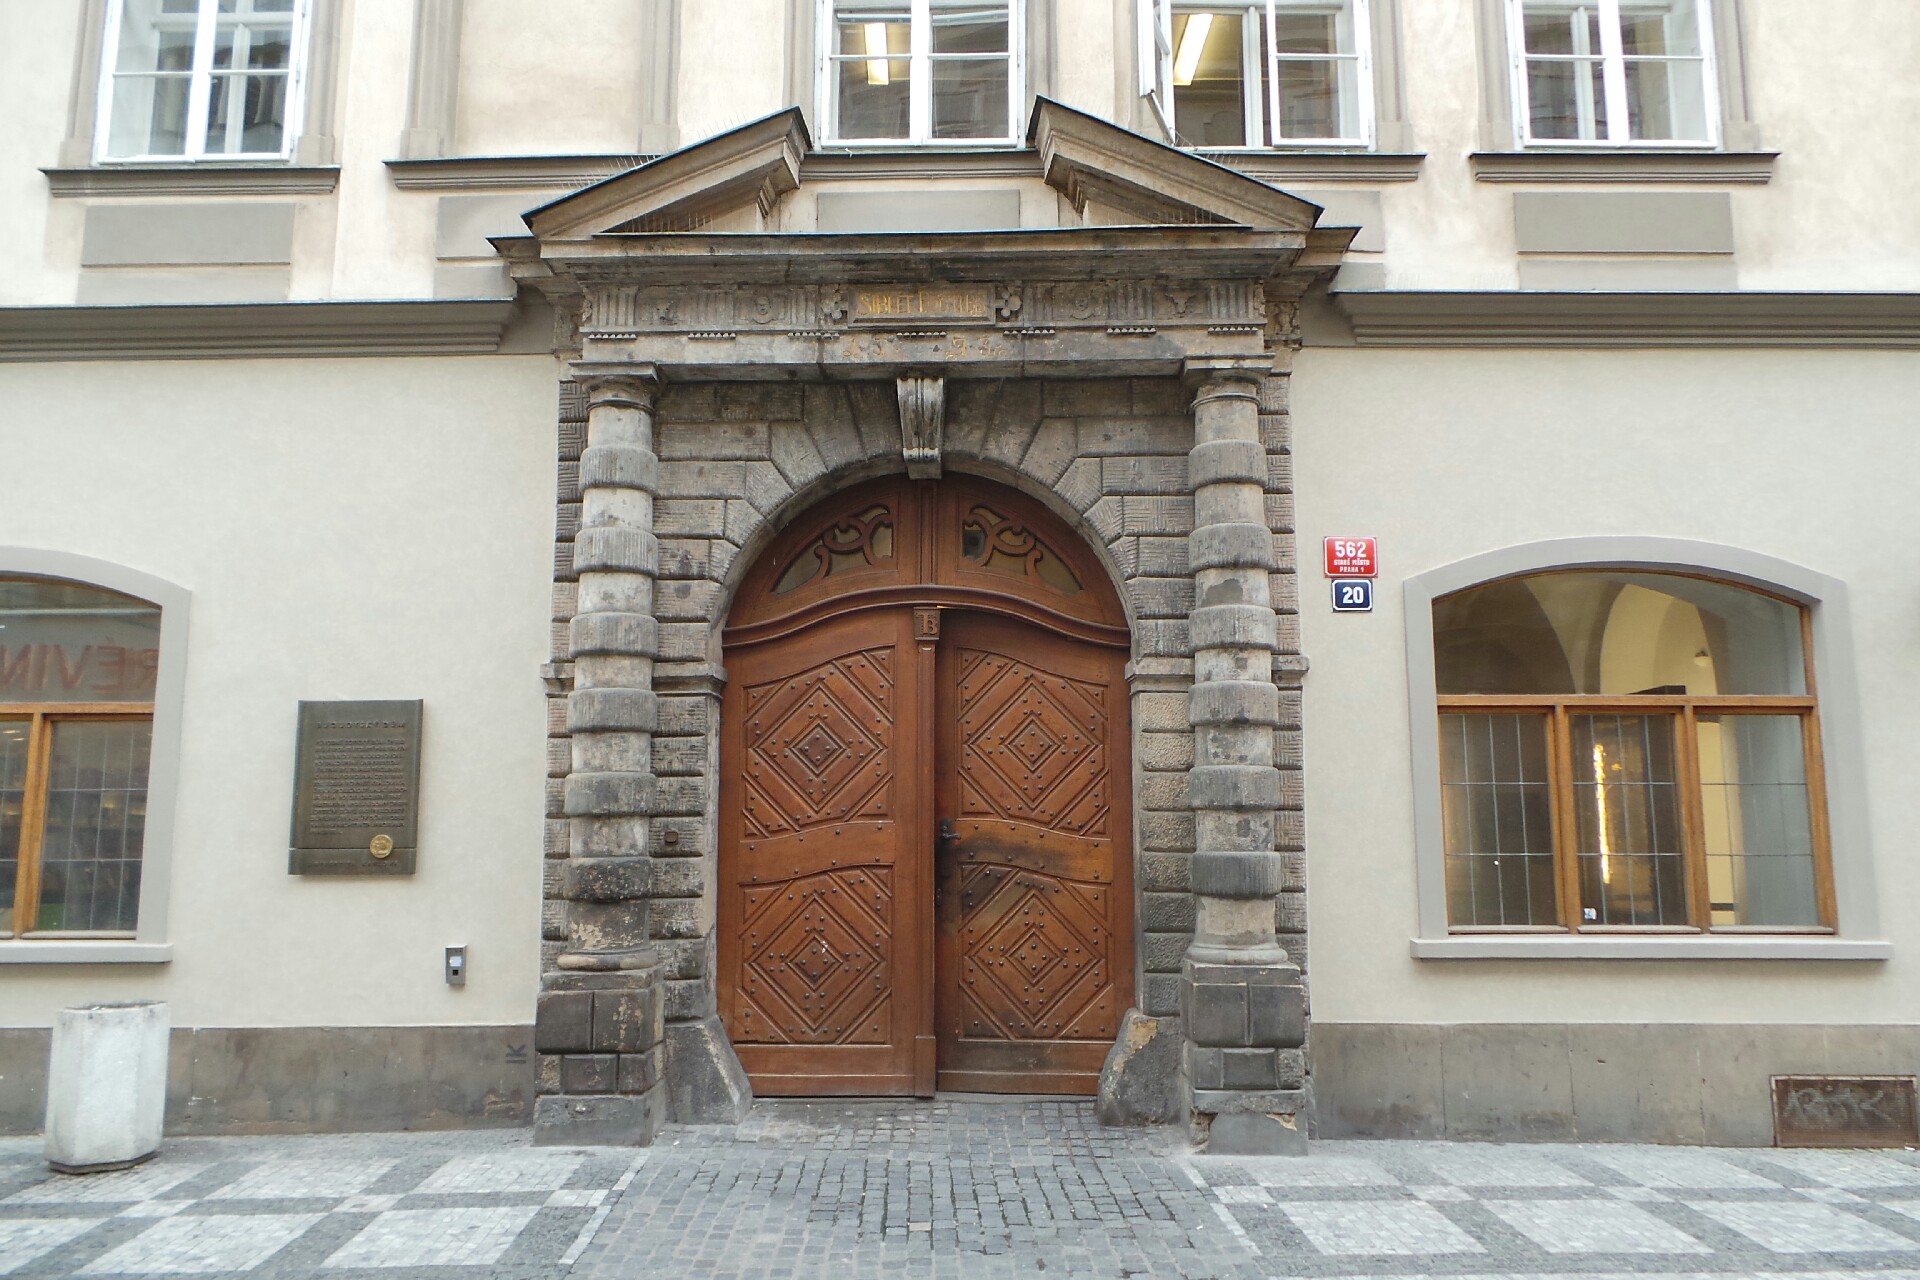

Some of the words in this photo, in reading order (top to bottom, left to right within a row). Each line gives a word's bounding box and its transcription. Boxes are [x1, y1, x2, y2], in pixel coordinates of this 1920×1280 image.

[1335, 541, 1366, 558] 562
[1333, 558, 1351, 566] STARÉ
[1351, 558, 1370, 566] MĚSTO
[1342, 586, 1364, 604] 20
